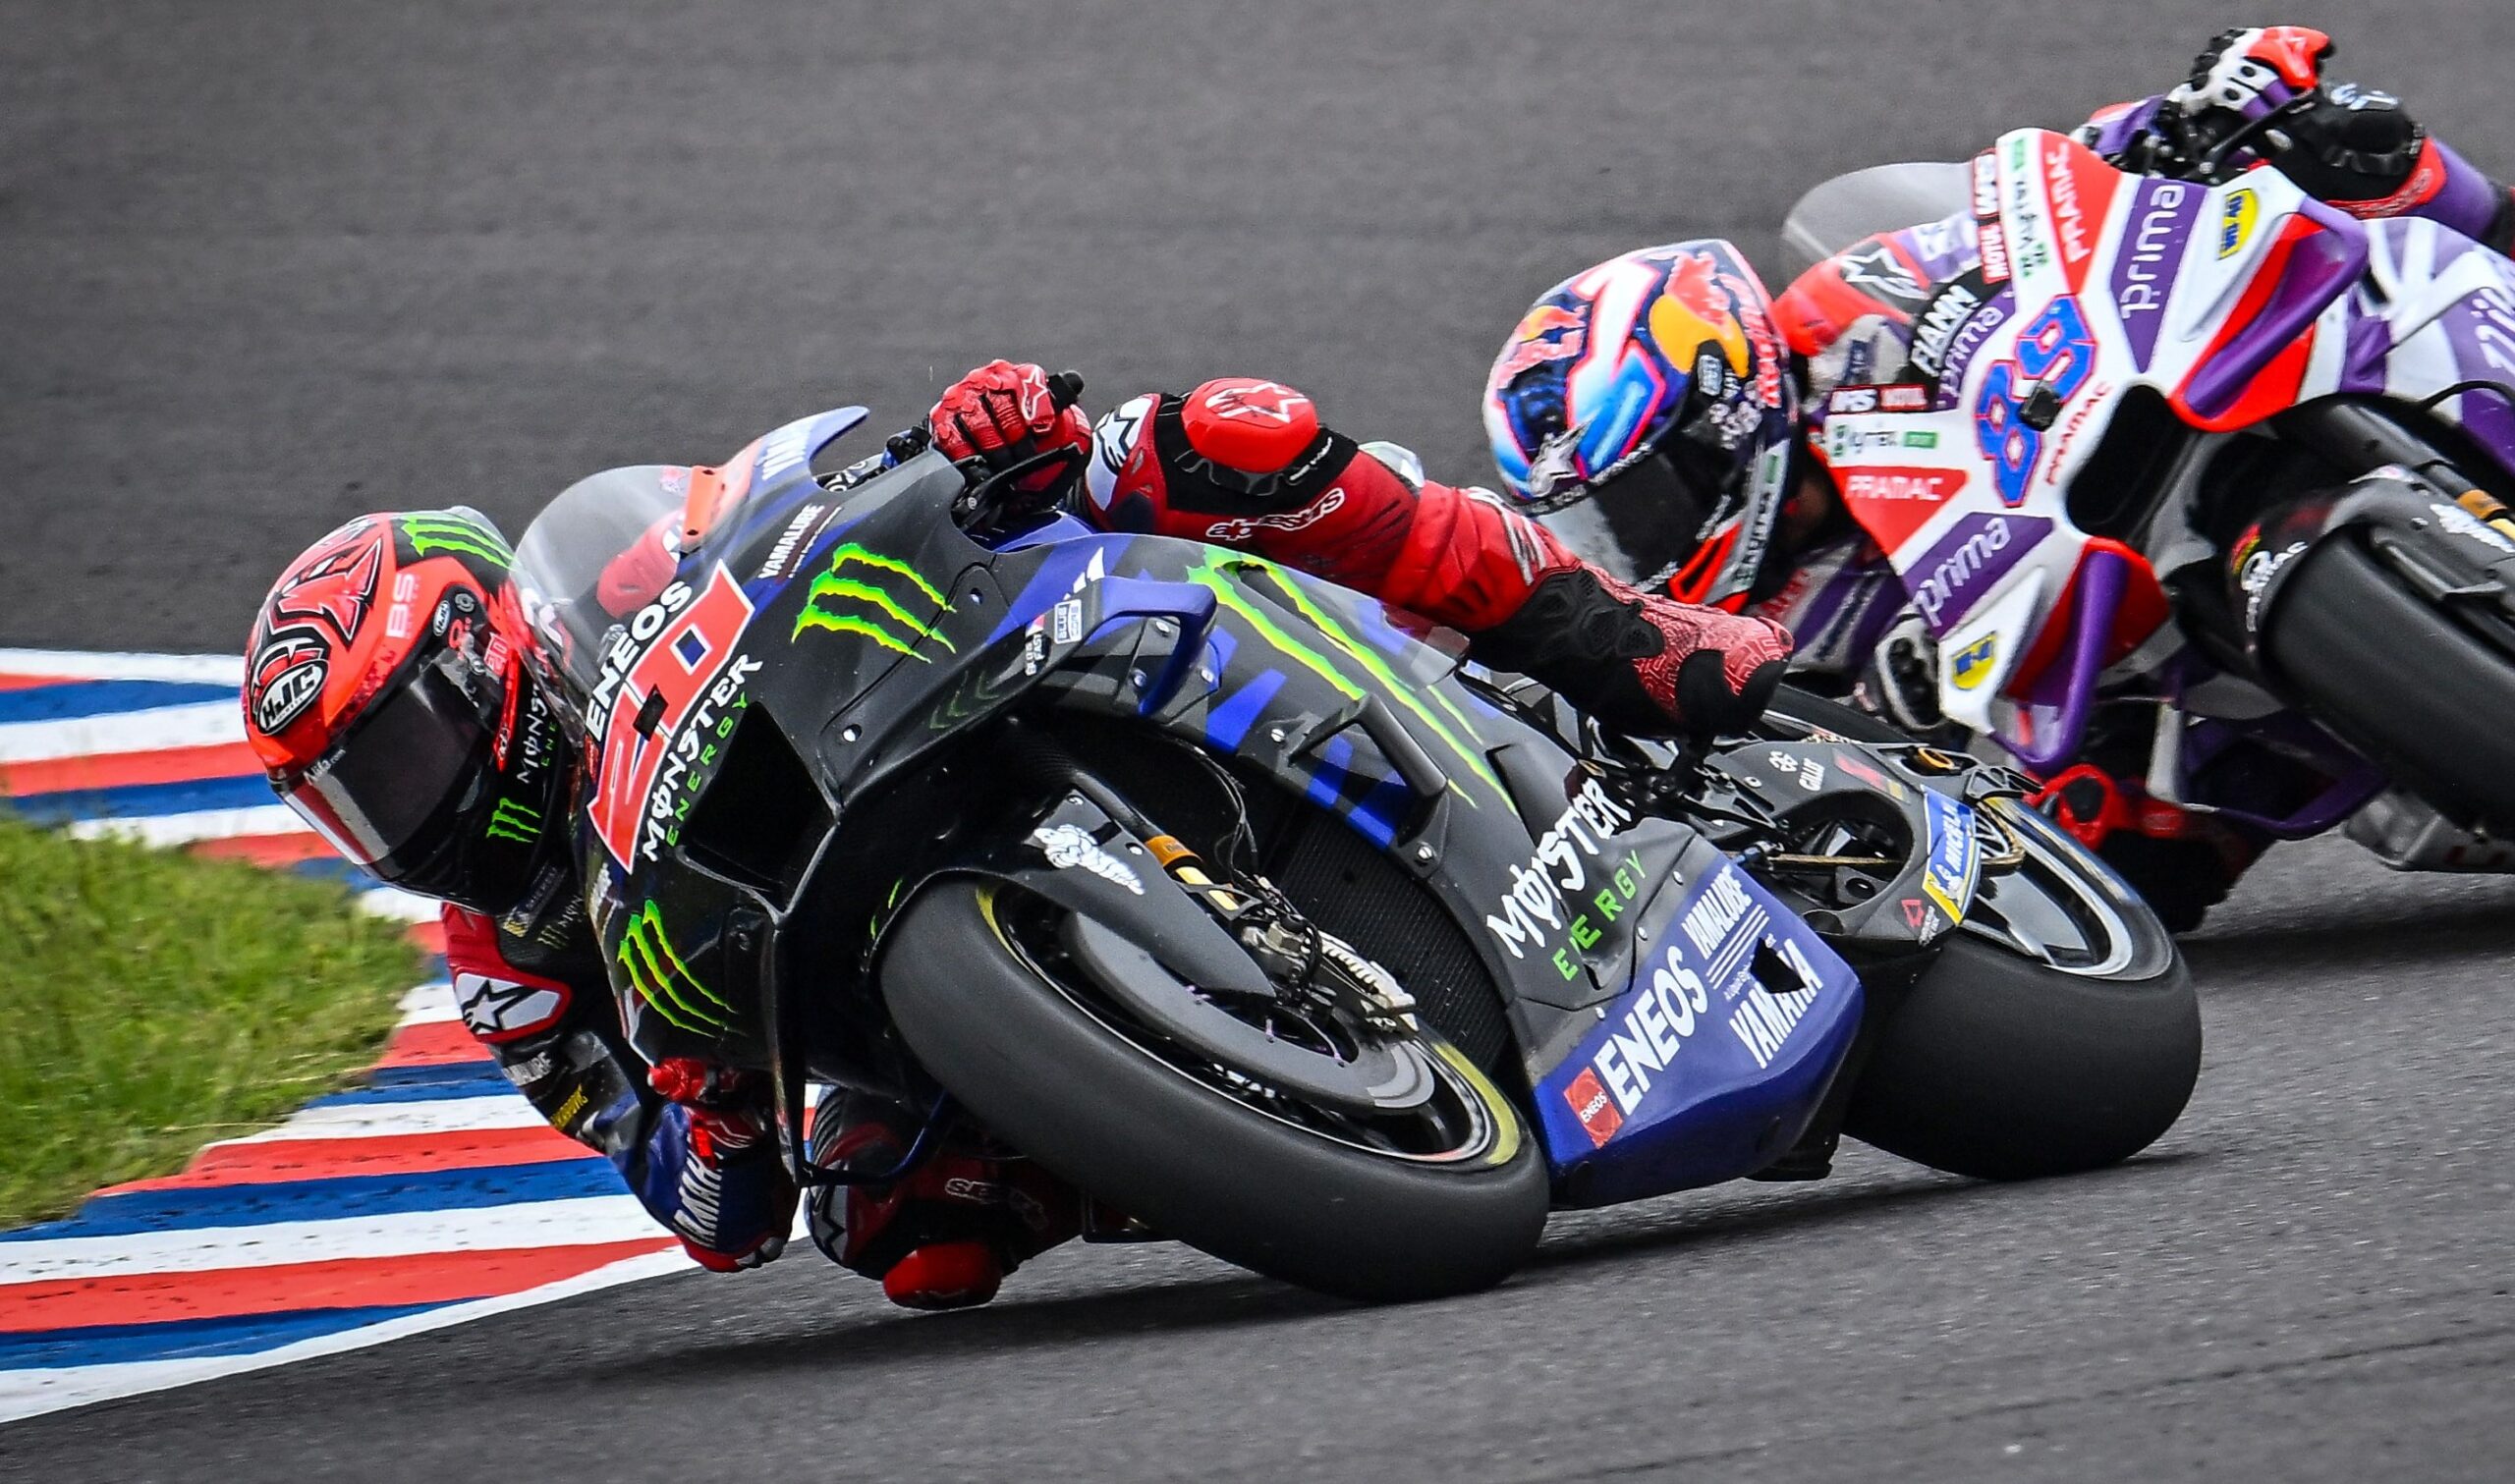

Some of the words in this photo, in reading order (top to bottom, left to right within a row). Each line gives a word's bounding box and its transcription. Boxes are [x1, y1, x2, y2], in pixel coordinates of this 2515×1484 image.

[2121, 185, 2186, 319] prima
[1938, 306, 2005, 400] prima
[1973, 293, 2101, 509] 89
[1914, 517, 2012, 626] prima
[261, 664, 316, 730] HJC
[587, 580, 694, 742] ENEOS
[516, 684, 549, 784] MONS
[641, 655, 763, 862] MONSTER
[666, 697, 750, 847] ENERGY
[1681, 863, 1754, 961] YAMALUBE
[1593, 945, 1709, 1116] ENEOS
[1579, 1089, 1608, 1124] ENEOS
